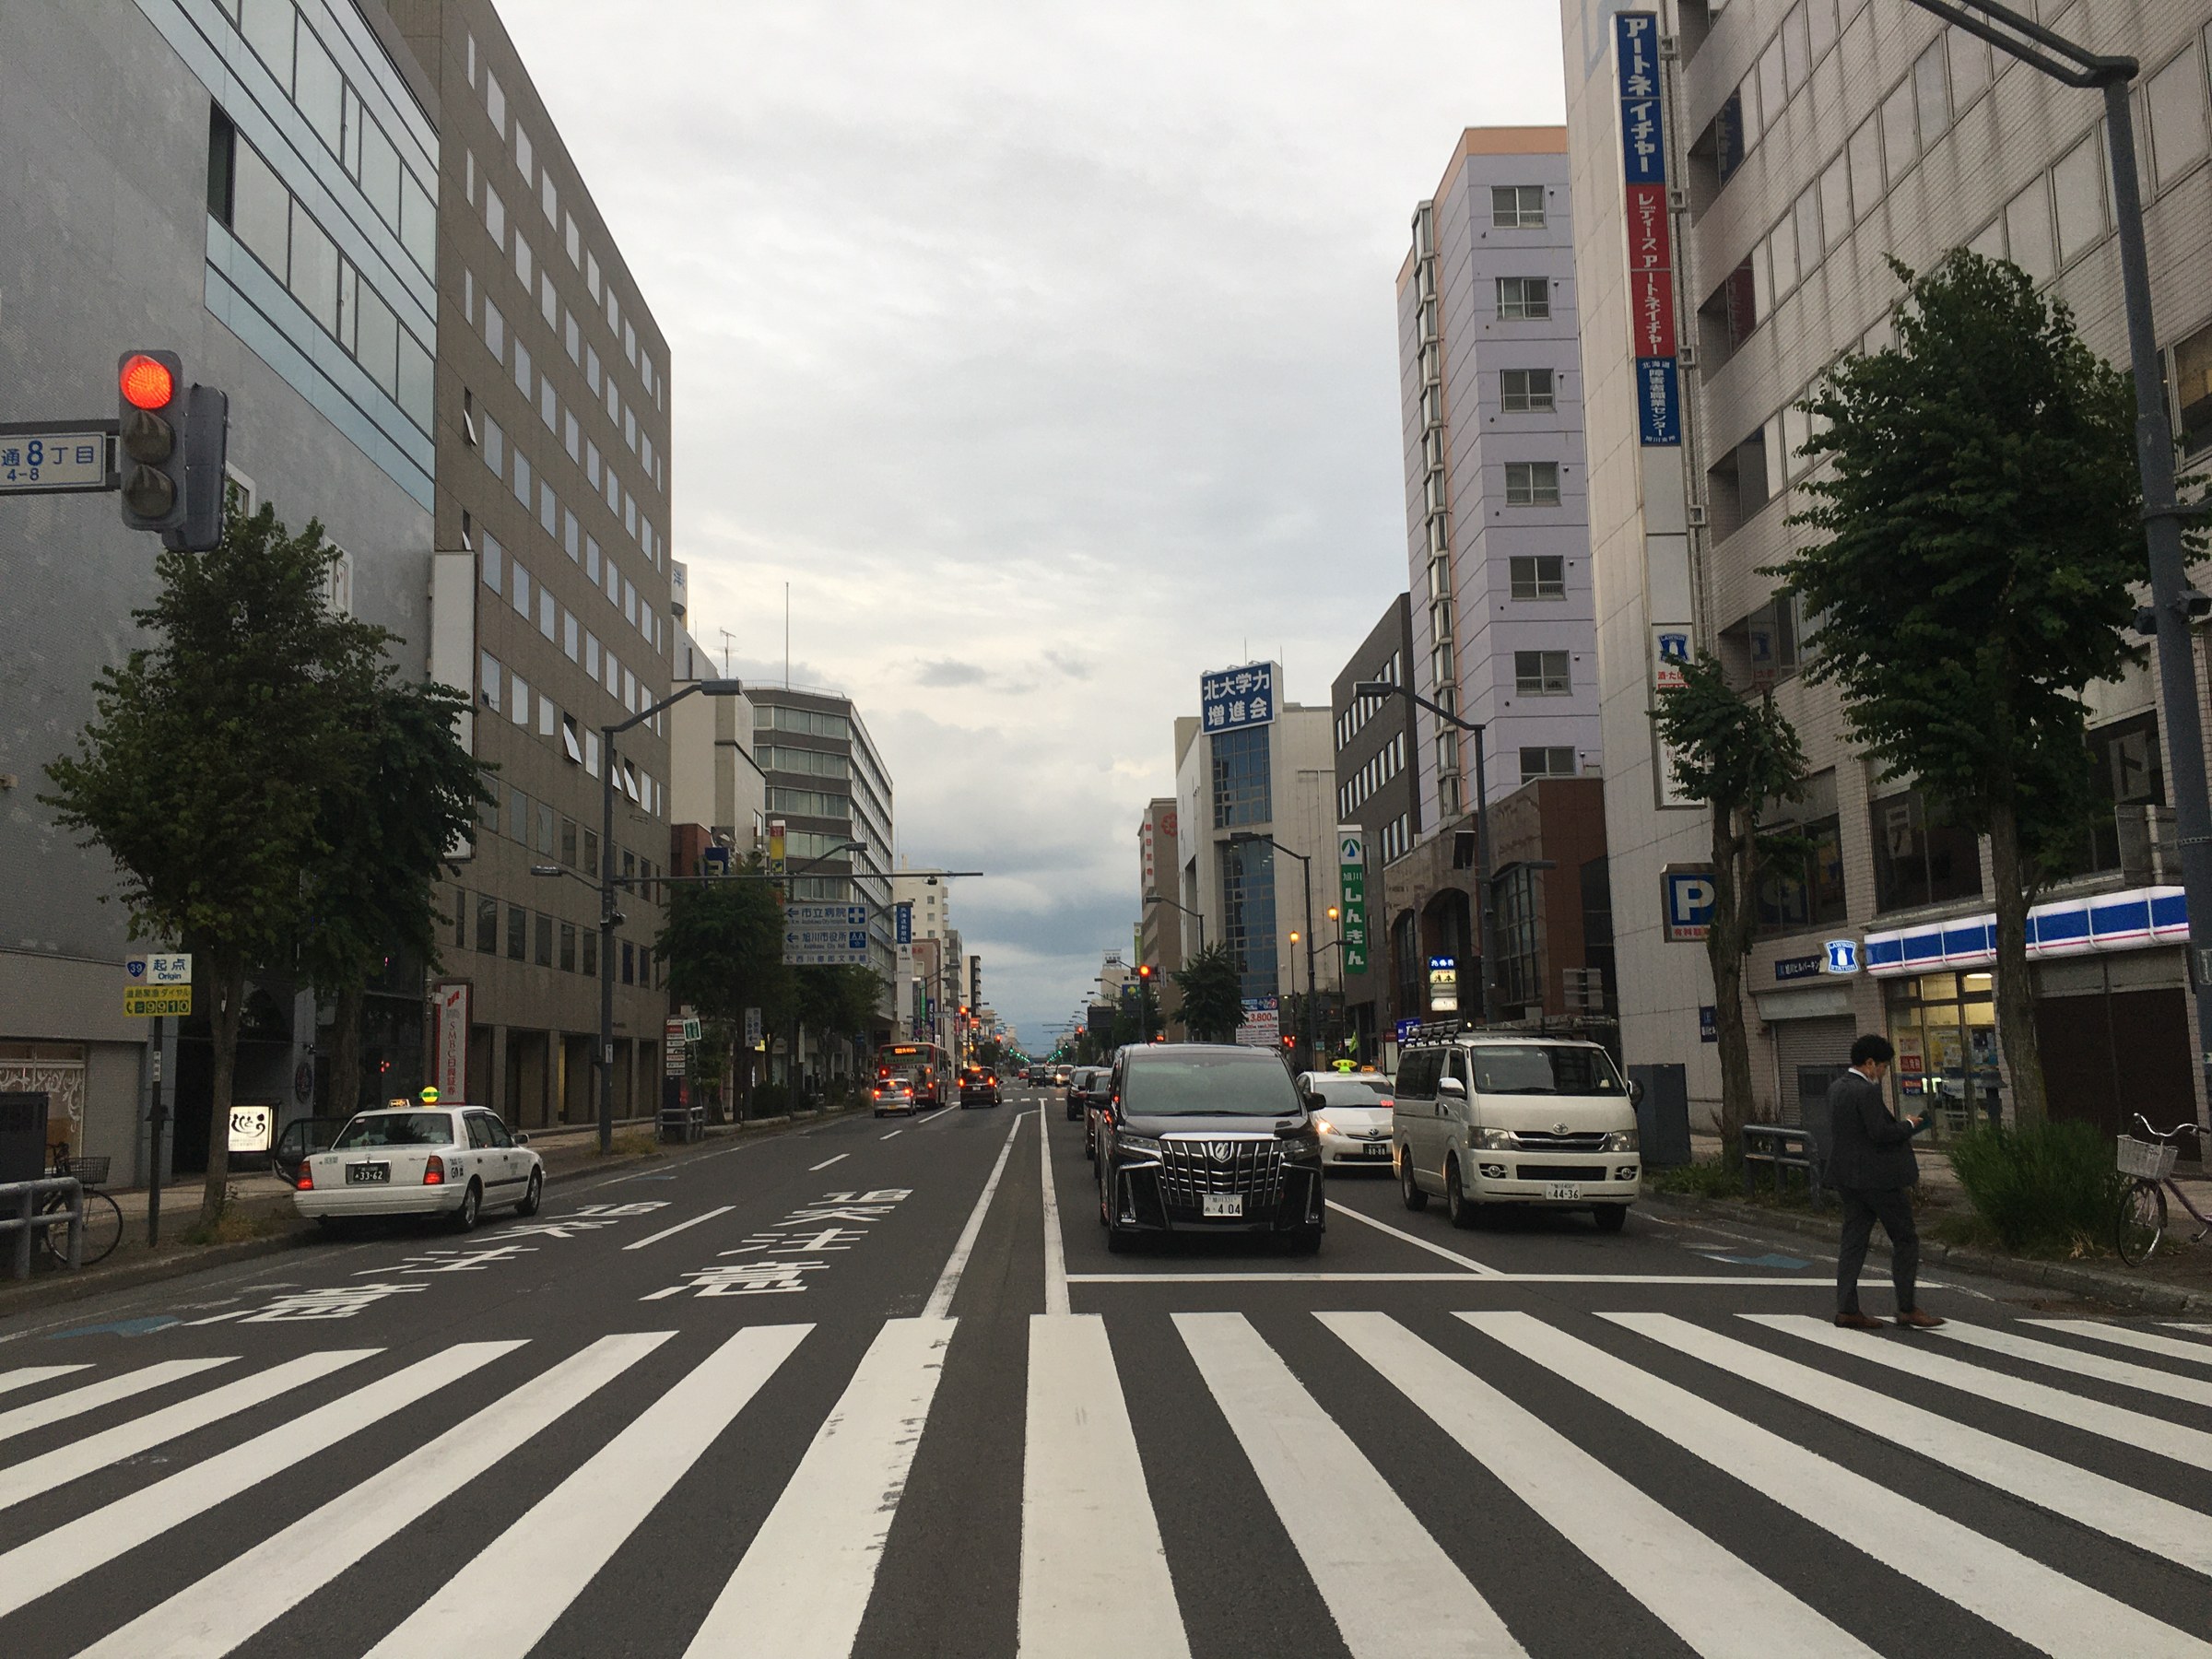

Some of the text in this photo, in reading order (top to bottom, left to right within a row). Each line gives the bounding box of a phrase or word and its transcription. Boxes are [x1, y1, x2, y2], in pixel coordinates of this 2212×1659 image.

[1624, 18, 1655, 173] アートネイチャー
[7, 468, 39, 481] 4-8
[1204, 669, 1270, 701] 北大学力
[1207, 697, 1267, 726] 増進会
[1343, 872, 1362, 882] 旭川
[1676, 880, 1715, 921] P
[1345, 888, 1364, 966] しんきん
[803, 932, 847, 943] 旭川市役所
[1829, 941, 1854, 950] LAWSON
[130, 963, 143, 973] 39
[153, 959, 186, 971] 起点
[1830, 963, 1856, 971] STATION
[158, 972, 182, 981] Origin
[360, 1171, 383, 1181] 33-62
[1553, 1189, 1579, 1199] 44-36
